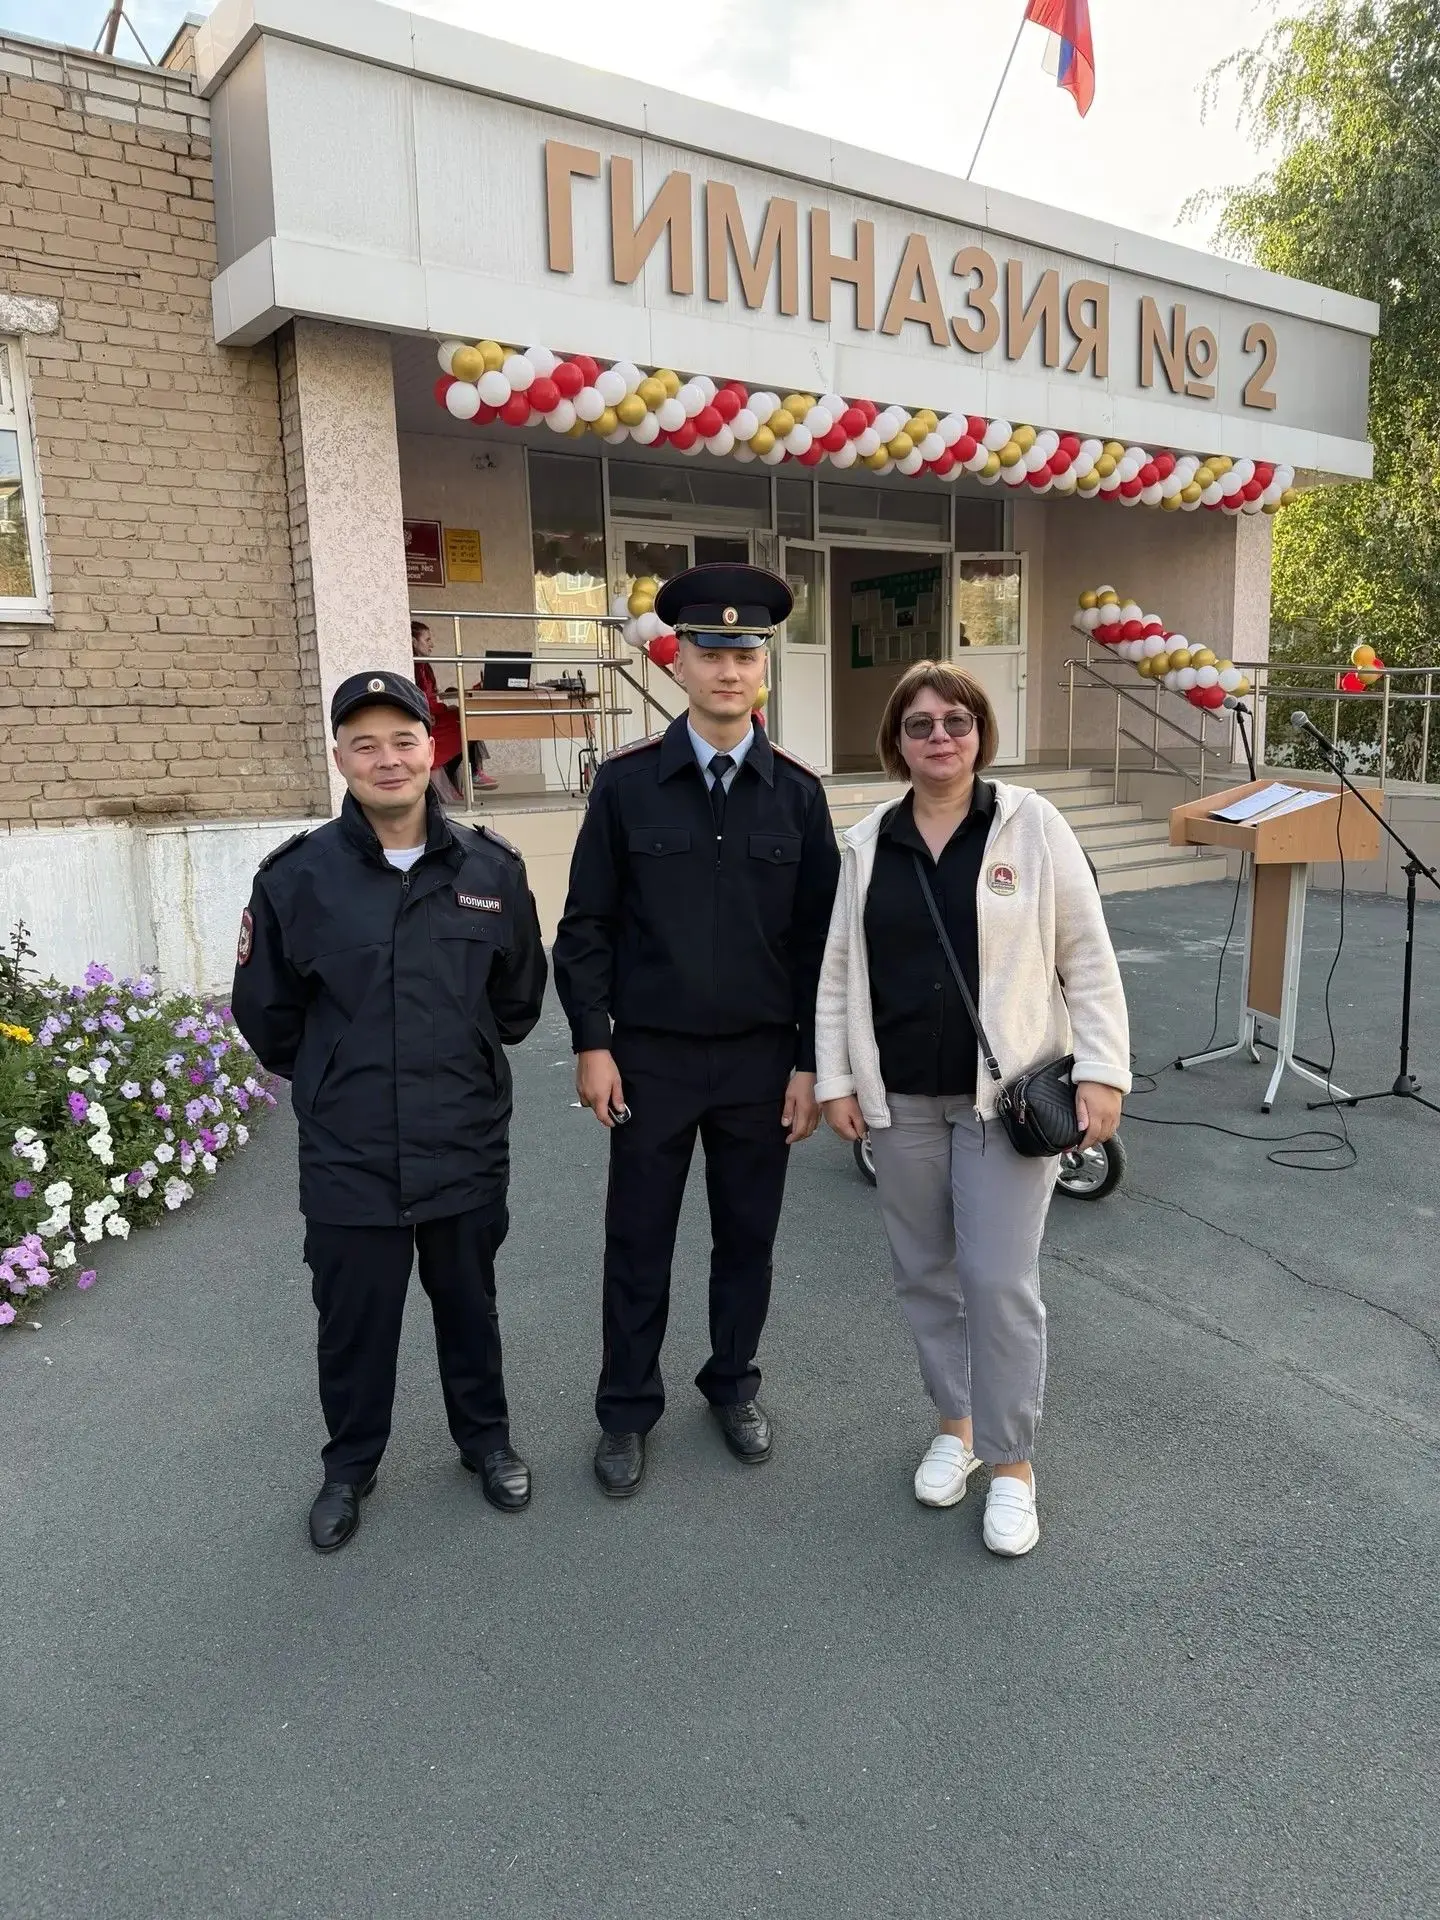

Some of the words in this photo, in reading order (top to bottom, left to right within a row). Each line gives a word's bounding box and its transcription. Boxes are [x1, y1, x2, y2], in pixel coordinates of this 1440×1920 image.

[545, 138, 1110, 378] ГИМНАЗИЯ
[1140, 295, 1218, 399] №
[1244, 321, 1278, 410] 2
[460, 895, 500, 910] ПОЛИЦИЯ
